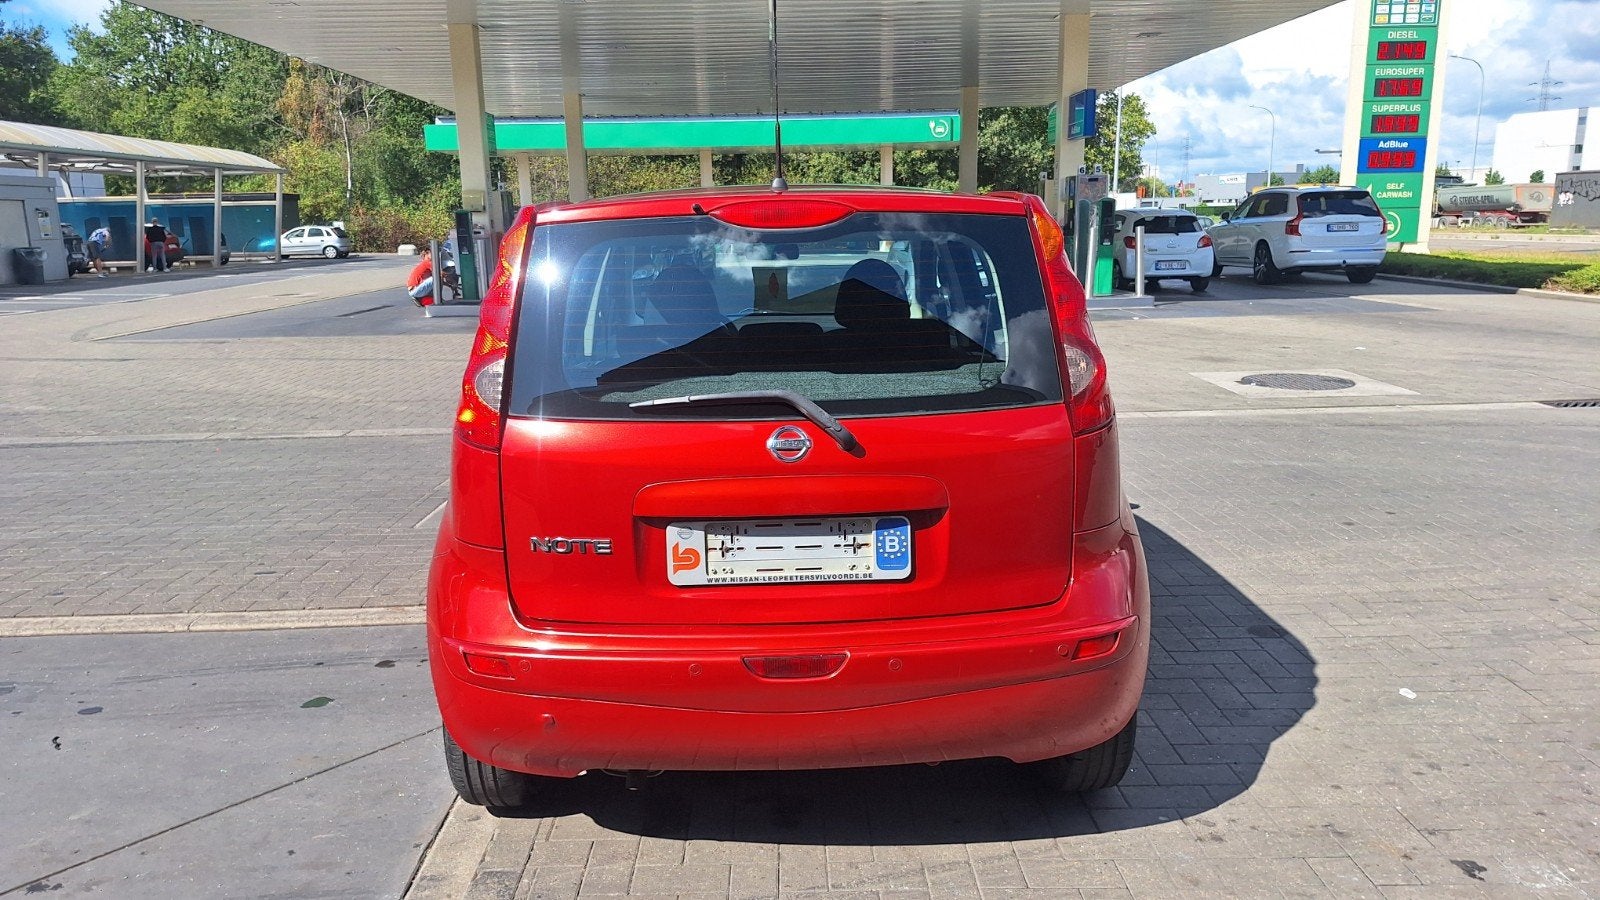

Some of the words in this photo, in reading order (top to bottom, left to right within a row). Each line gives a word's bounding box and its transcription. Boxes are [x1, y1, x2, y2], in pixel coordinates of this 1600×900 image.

[1387, 30, 1419, 39] DIESEL
[1375, 67, 1425, 76] EUROSUPER
[1372, 104, 1422, 112] SUPERPLUS
[1378, 140, 1409, 149] AdBlue
[1079, 166, 1085, 174] 6
[1386, 182, 1405, 190] SELF
[1376, 190, 1413, 198] CARWASH
[529, 536, 613, 555] NOTE
[885, 535, 900, 553] B
[706, 573, 874, 584] WWW.NISSAN-LEOPEETERSVILVOORDE.BE
